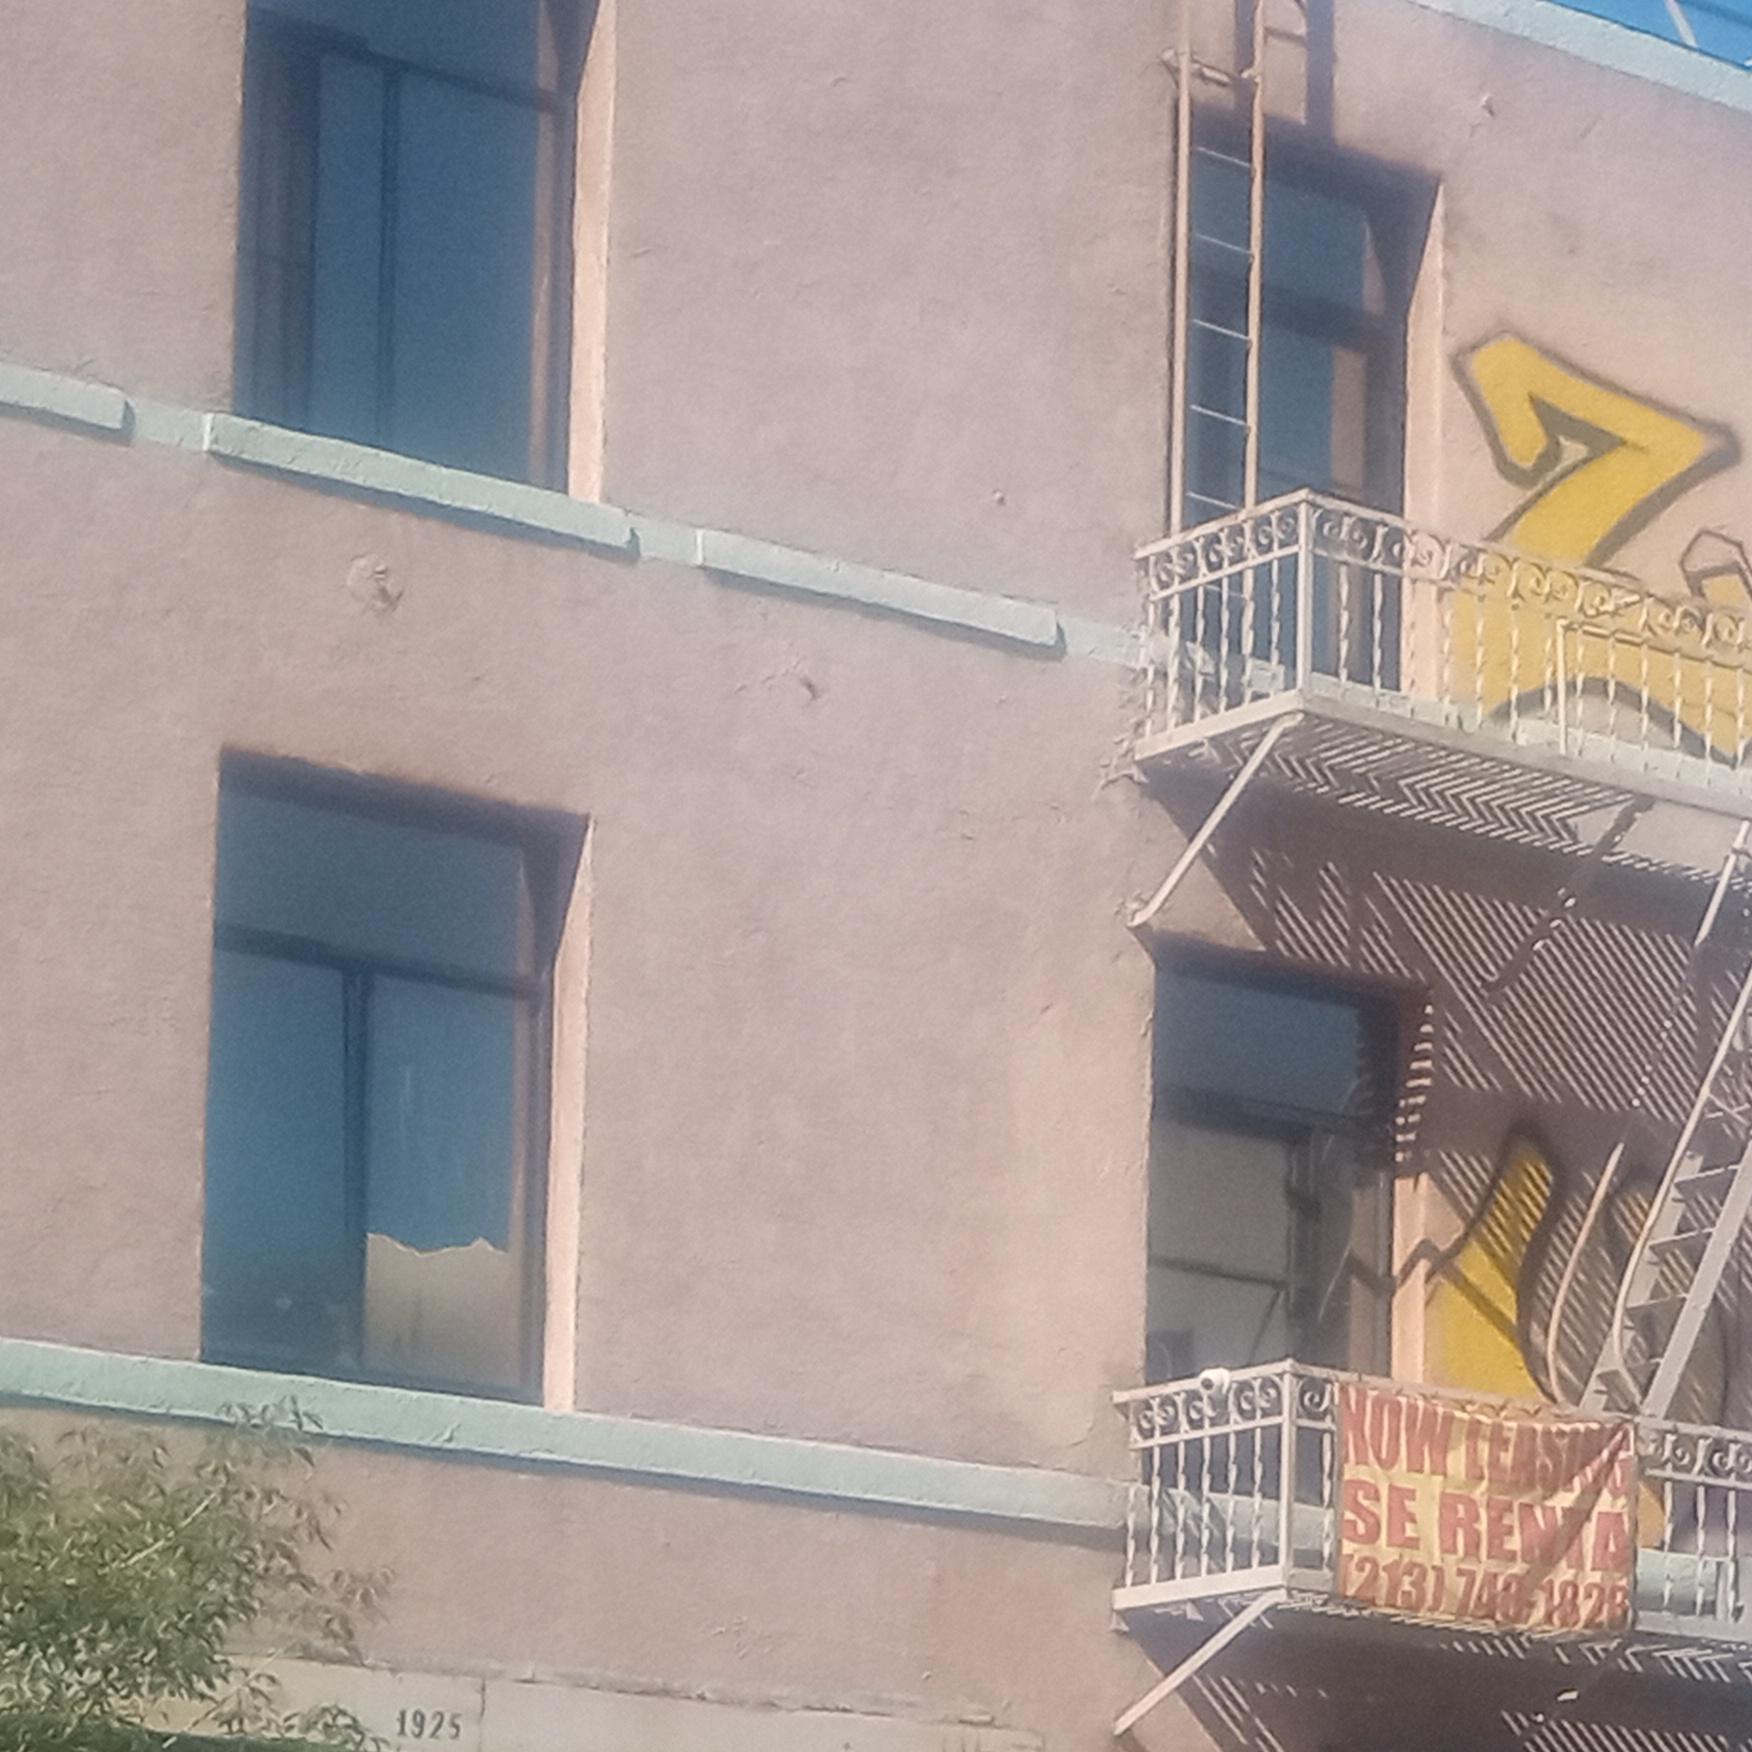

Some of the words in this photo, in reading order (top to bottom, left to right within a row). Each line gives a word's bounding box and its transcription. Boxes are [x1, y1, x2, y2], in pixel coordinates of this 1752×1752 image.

[1340, 1384, 1455, 1475] NOW
[1342, 1479, 1420, 1550] SE
[1438, 1491, 1633, 1573] RENTA
[1341, 1554, 1445, 1612] (213)
[397, 1708, 462, 1740] 1925
